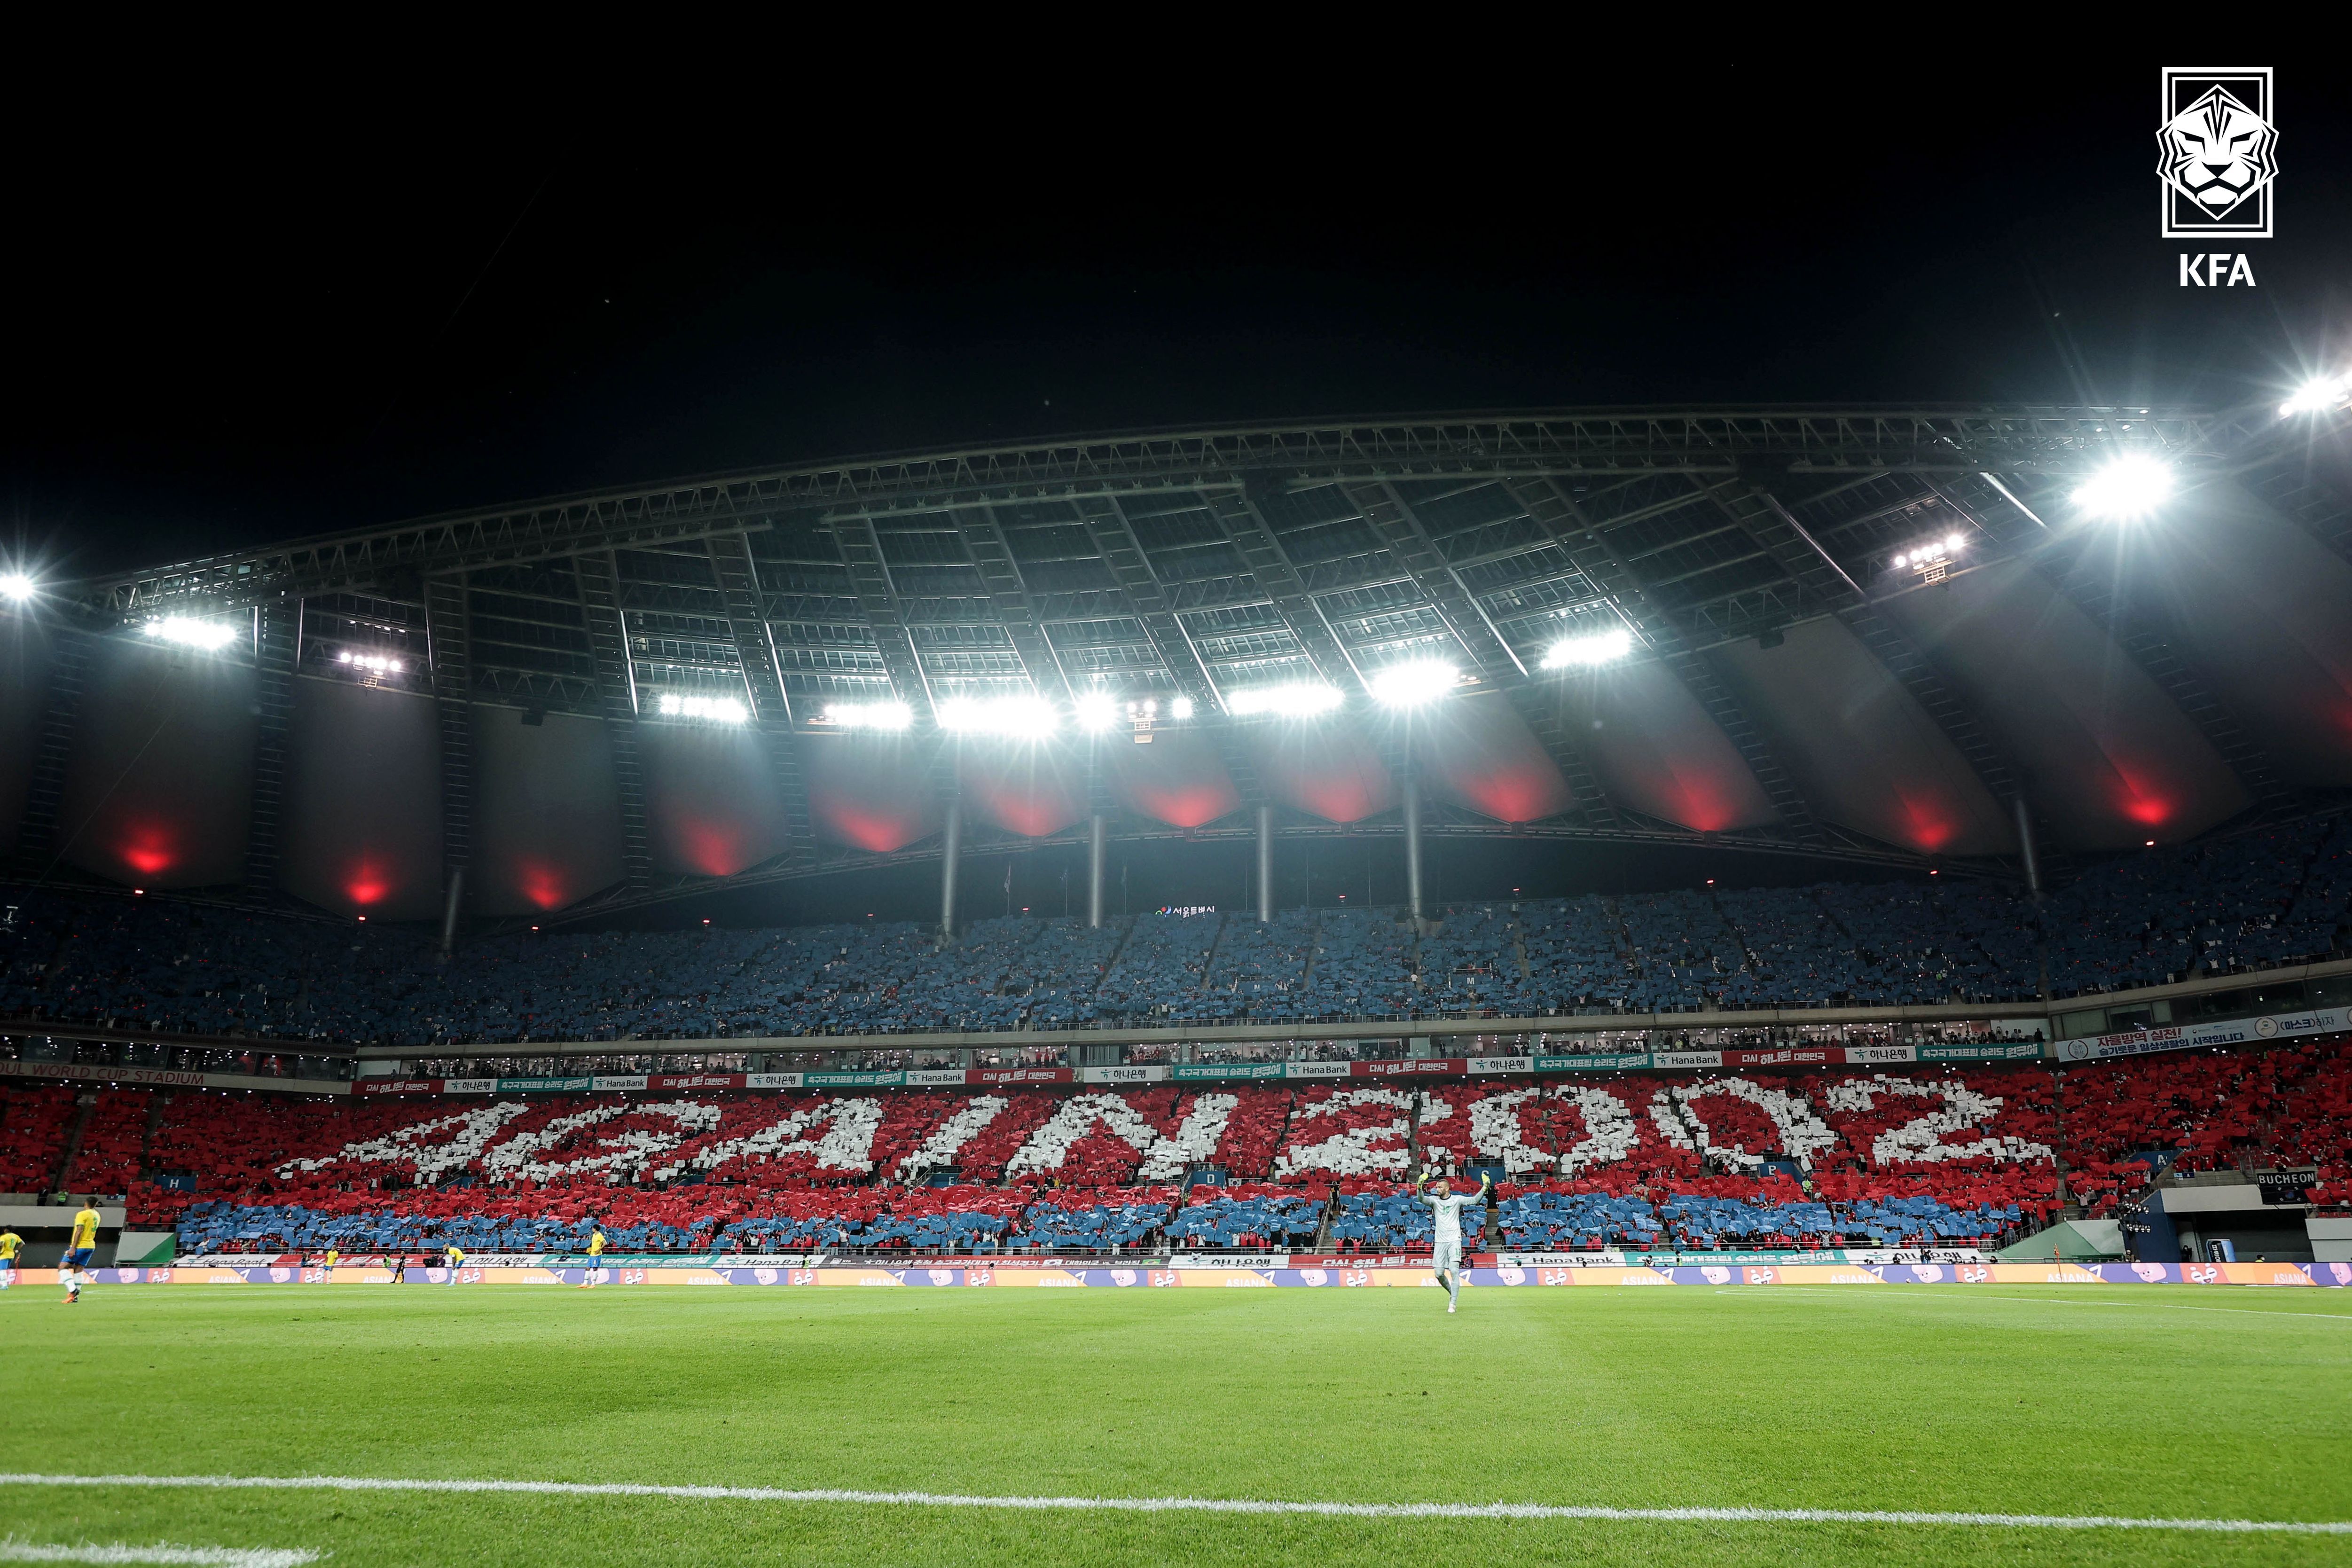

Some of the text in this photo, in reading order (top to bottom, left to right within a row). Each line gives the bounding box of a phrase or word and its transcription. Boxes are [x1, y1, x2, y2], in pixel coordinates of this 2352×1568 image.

[2097, 1027, 2181, 1047] 자율방역 실천!
[2099, 1032, 2244, 1056] 슬기로운 일상생활의 시작입니다
[1742, 1054, 1757, 1063] 다시
[1794, 1052, 1826, 1061] 대한민국
[1870, 1049, 1907, 1060] 하나은행
[1922, 1048, 1978, 1058] 축구국가대표팀
[1980, 1047, 2005, 1056] 승리도
[1490, 1060, 1525, 1070] 하나은행
[1539, 1058, 1592, 1068] 축구국가대표팀
[1593, 1058, 1617, 1067] 승리도
[1671, 1055, 1718, 1065] Hana Bank
[1178, 1067, 1228, 1077] 축구국가대표팀
[1230, 1068, 1251, 1076] 승리도
[1326, 1065, 1347, 1074] Bank
[1369, 1064, 1384, 1073] 다시
[1418, 1062, 1448, 1071] 대한민국
[33, 1065, 90, 1078] WORLD
[97, 1068, 128, 1080] CUP
[133, 1070, 204, 1085] STADIUM
[808, 1074, 853, 1084] 축구국가대표팀
[855, 1074, 875, 1083] 승리도
[982, 1072, 997, 1081] 다시
[1028, 1071, 1056, 1080] 대한민국
[1113, 1069, 1146, 1079] 하나은행
[705, 1077, 730, 1086] 대한민국
[766, 1075, 796, 1085] 하나은행
[463, 1081, 490, 1090] 하나은행
[272, 1093, 1239, 1187] AGAIN
[2157, 1155, 2167, 1165] A
[1768, 1165, 1776, 1176] B
[949, 1176, 955, 1185] E
[1207, 1174, 1215, 1184] D
[2259, 1172, 2314, 1184] BUCHEON
[170, 1179, 179, 1188] H
[1211, 1259, 1270, 1267] 하나은행
[1622, 1276, 1666, 1286] ASIANA
[1831, 1275, 1876, 1284] ASIANA
[2047, 1274, 2096, 1283] ASIANA
[2274, 1273, 2307, 1284] ASIANA
